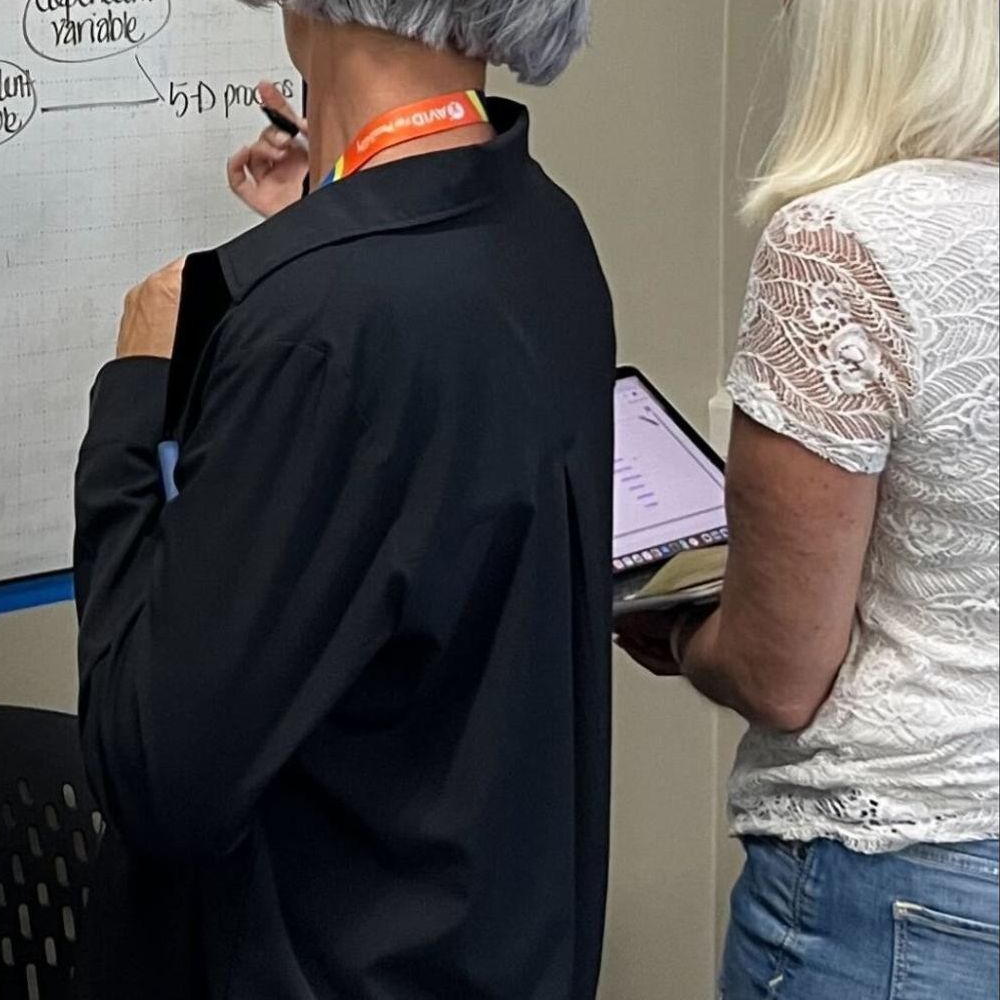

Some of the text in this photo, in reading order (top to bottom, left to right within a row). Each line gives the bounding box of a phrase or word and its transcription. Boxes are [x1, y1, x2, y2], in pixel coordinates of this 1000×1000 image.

[52, 10, 146, 47] variable
[169, 81, 216, 118] 5-D
[411, 104, 448, 127] AVID
